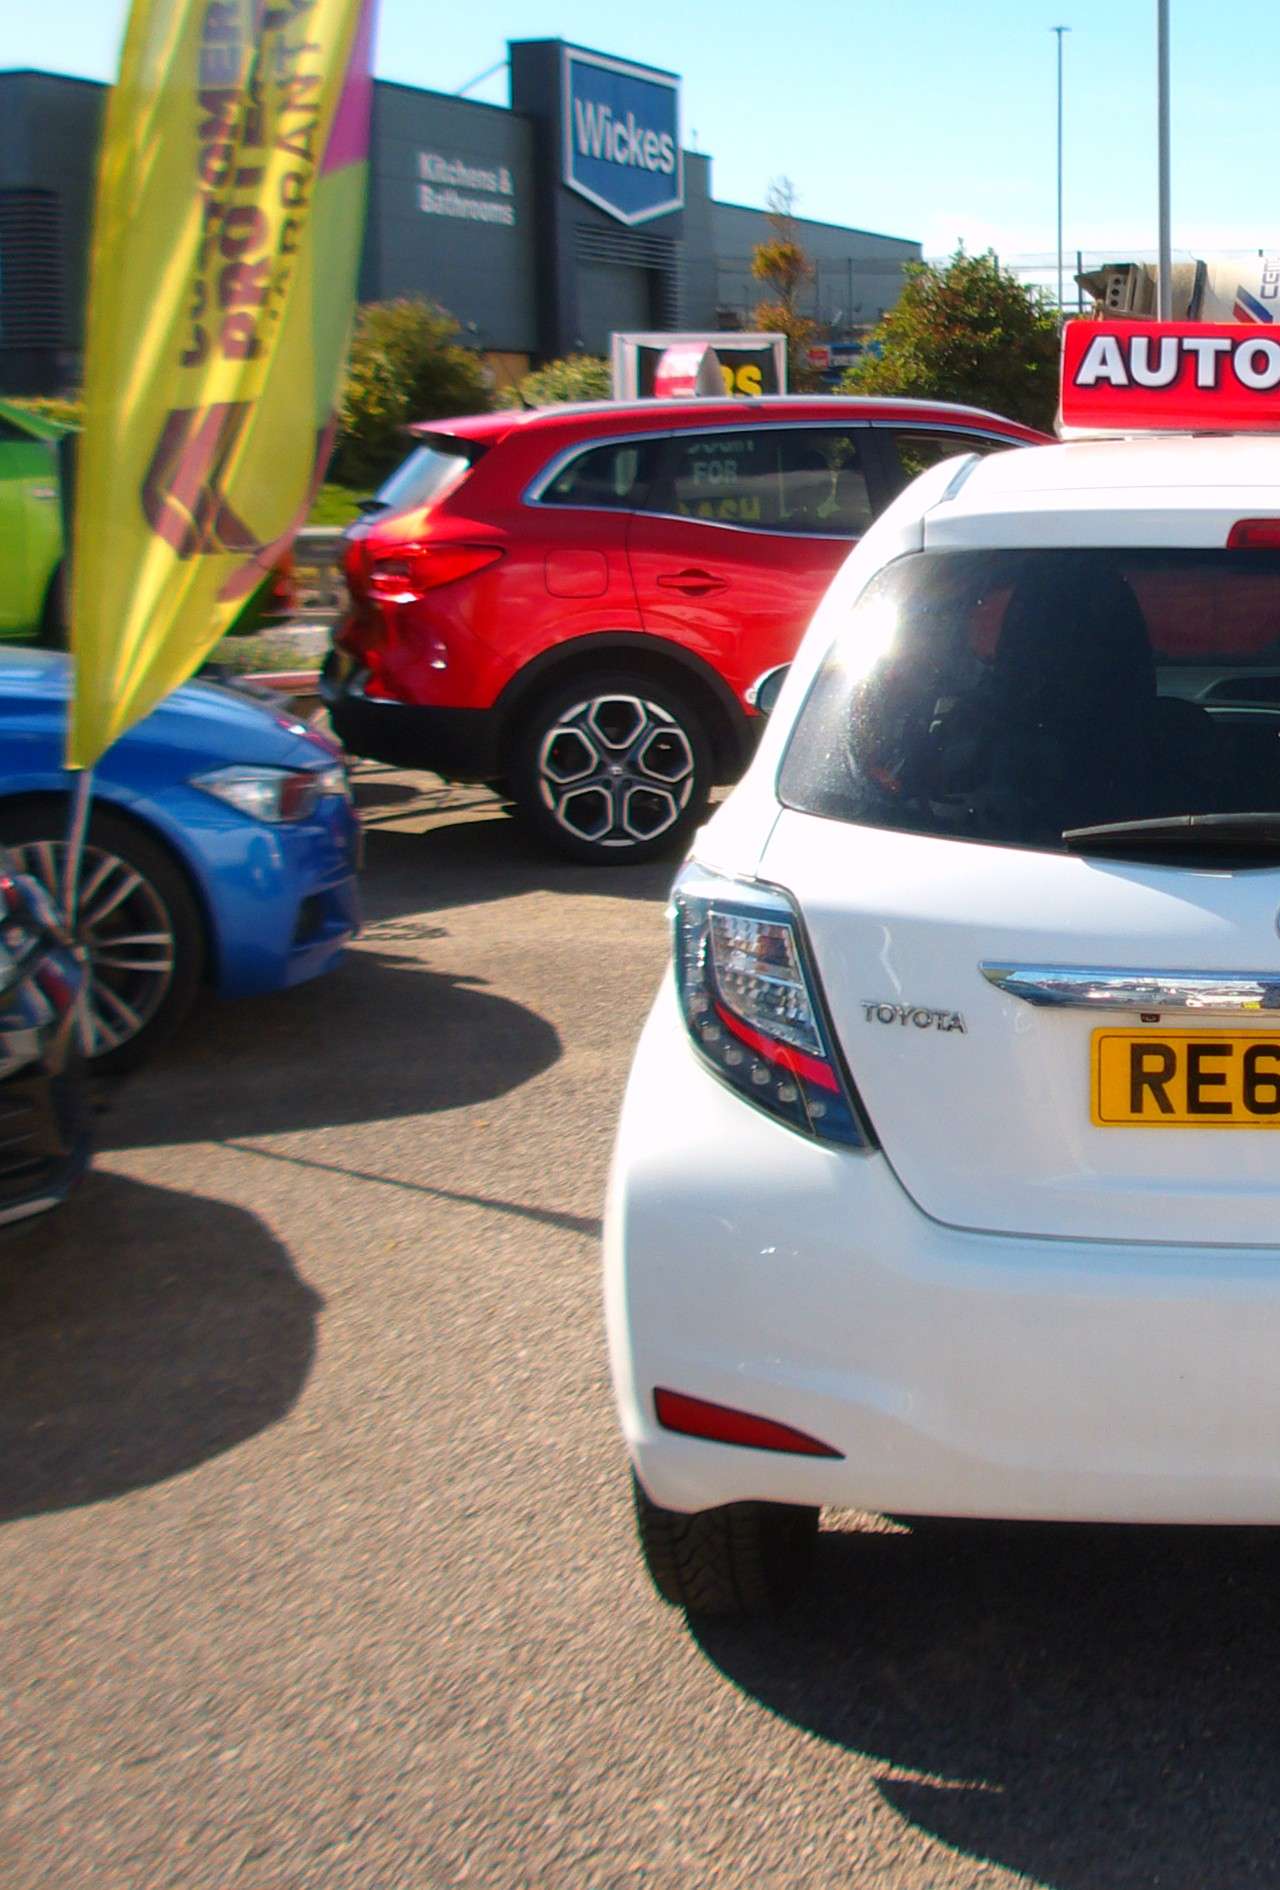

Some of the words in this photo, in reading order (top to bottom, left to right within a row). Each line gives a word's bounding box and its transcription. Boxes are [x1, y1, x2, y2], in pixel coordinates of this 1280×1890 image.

[574, 96, 677, 175] Wickes
[418, 152, 497, 192] Kitchens
[418, 184, 515, 227] Bathrooms
[861, 1001, 967, 1035] TOYOTA
